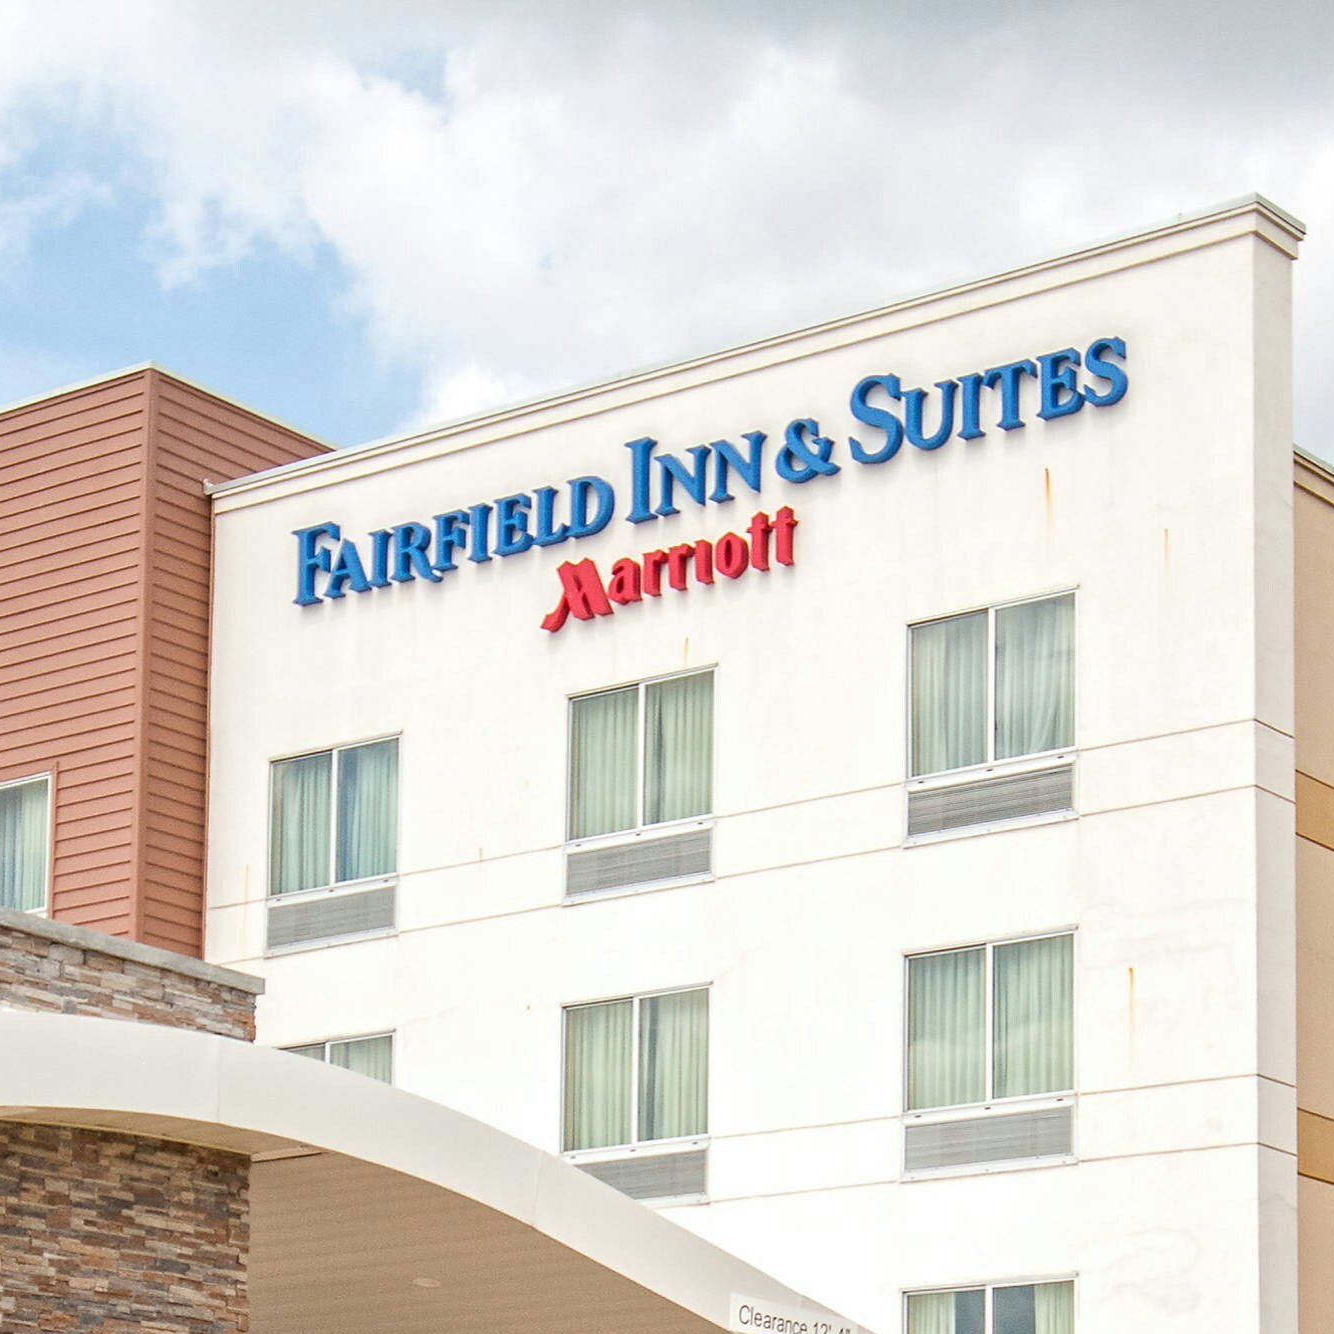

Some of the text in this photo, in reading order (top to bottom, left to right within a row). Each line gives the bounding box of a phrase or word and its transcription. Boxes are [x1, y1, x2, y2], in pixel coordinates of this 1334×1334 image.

[292, 335, 1128, 606] FAIRFIELD INN & SUITES
[540, 505, 799, 634] Marriott
